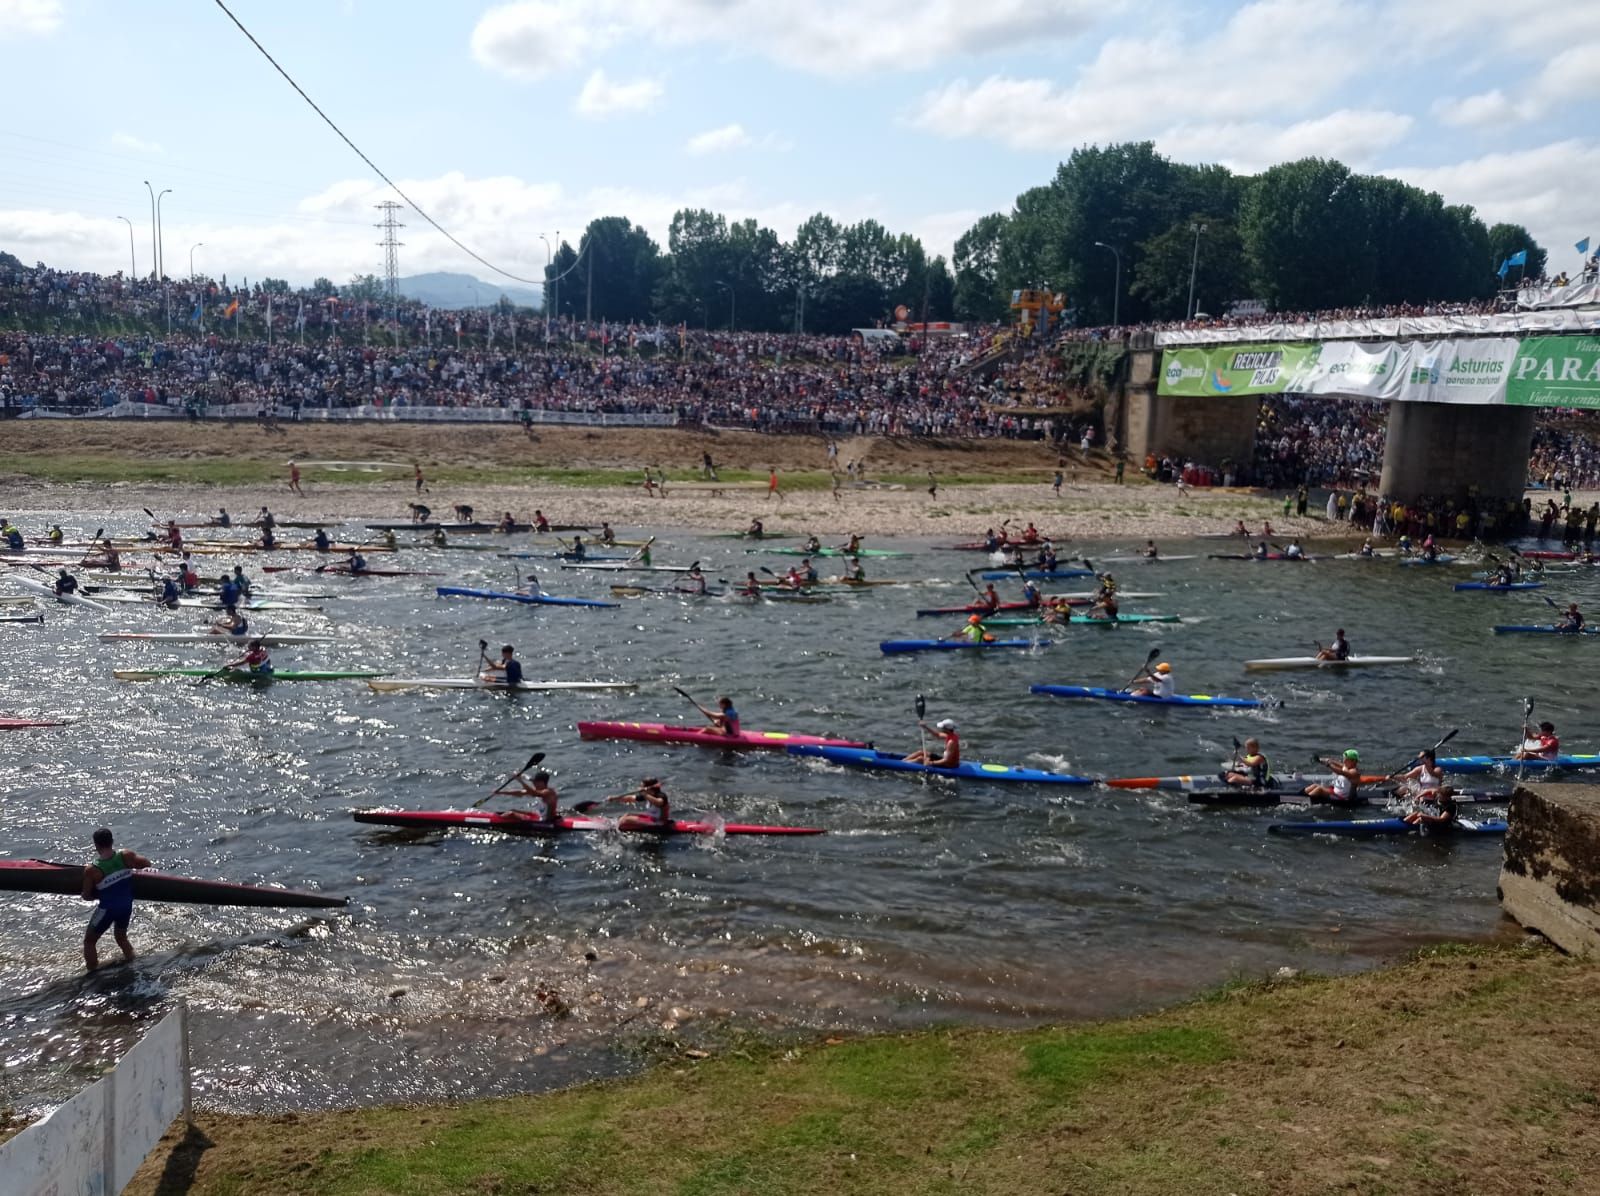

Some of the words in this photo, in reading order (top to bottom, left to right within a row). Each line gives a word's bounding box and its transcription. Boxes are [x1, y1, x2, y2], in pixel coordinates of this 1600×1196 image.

[1234, 352, 1274, 369] RECICLA
[1449, 355, 1504, 373] Asturias
[1514, 357, 1600, 381] PARA
[1252, 368, 1279, 385] PILAS
[1529, 390, 1560, 403] Vuelve
